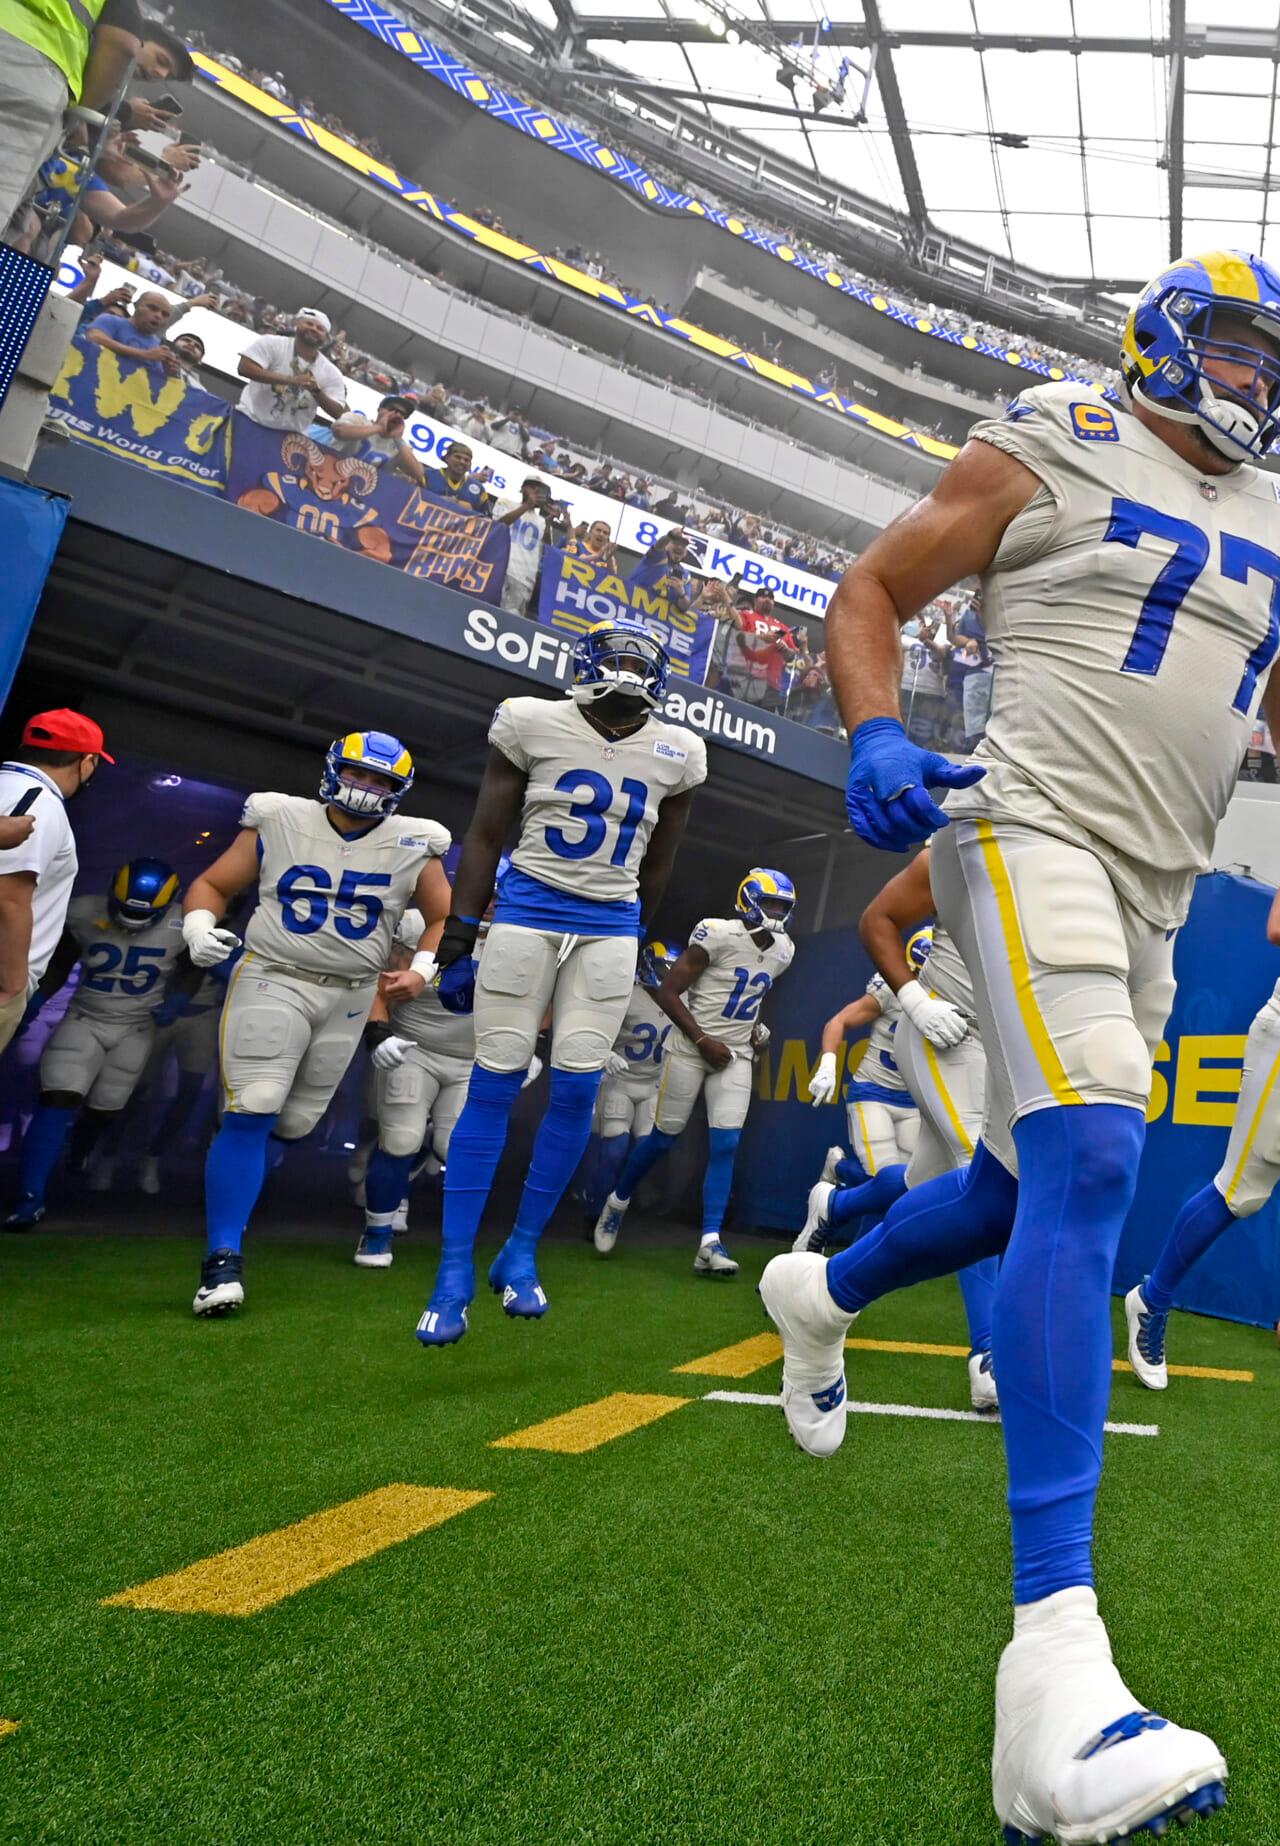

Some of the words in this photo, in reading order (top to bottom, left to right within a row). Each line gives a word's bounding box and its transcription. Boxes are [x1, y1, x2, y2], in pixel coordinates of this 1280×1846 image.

[97, 425, 163, 460] World
[1073, 404, 1116, 432] C
[561, 556, 698, 634] RAMS
[711, 548, 736, 576] K
[555, 581, 695, 657] HOUSE
[463, 609, 569, 680] SoFi
[655, 692, 777, 755] adium
[544, 768, 648, 867] 31
[276, 864, 392, 941] 65
[82, 942, 167, 996] 25
[721, 966, 773, 1022] 12
